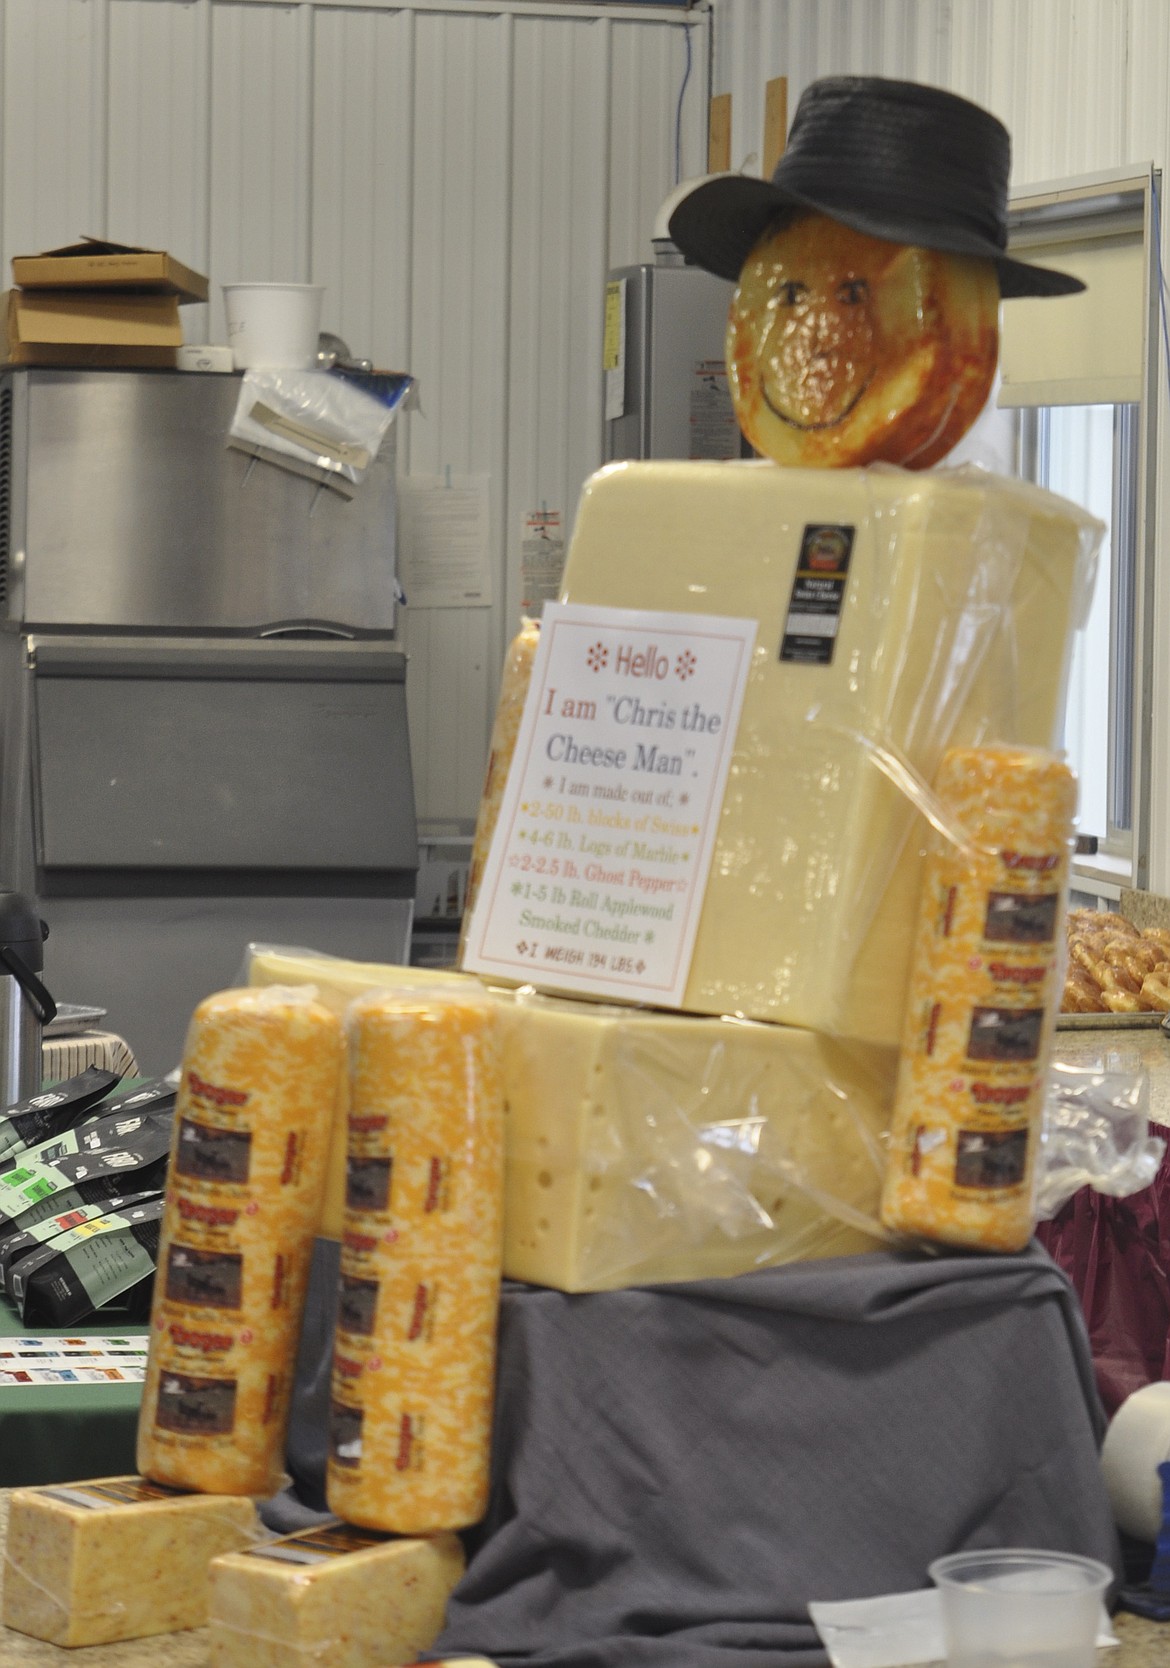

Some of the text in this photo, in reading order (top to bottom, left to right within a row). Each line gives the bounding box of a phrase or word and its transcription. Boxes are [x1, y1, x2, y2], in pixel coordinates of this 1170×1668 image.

[615, 645, 669, 680] Hello
[544, 688, 556, 715] I
[561, 698, 597, 720] am
[682, 704, 722, 734] the
[546, 733, 627, 768] Cheese
[559, 777, 566, 794] I
[568, 783, 589, 797] am
[593, 782, 628, 802] made
[631, 790, 653, 805] out
[587, 807, 631, 830] blocks
[634, 815, 649, 832] of
[579, 834, 611, 858] Logs
[614, 840, 630, 857] of
[632, 840, 678, 864] Marble
[583, 863, 624, 886] Ghost
[628, 869, 677, 895] Pepper
[569, 889, 599, 910] Roll
[601, 894, 675, 921] Applewood
[519, 909, 580, 936] Smoked
[544, 946, 584, 965] WEIGH
